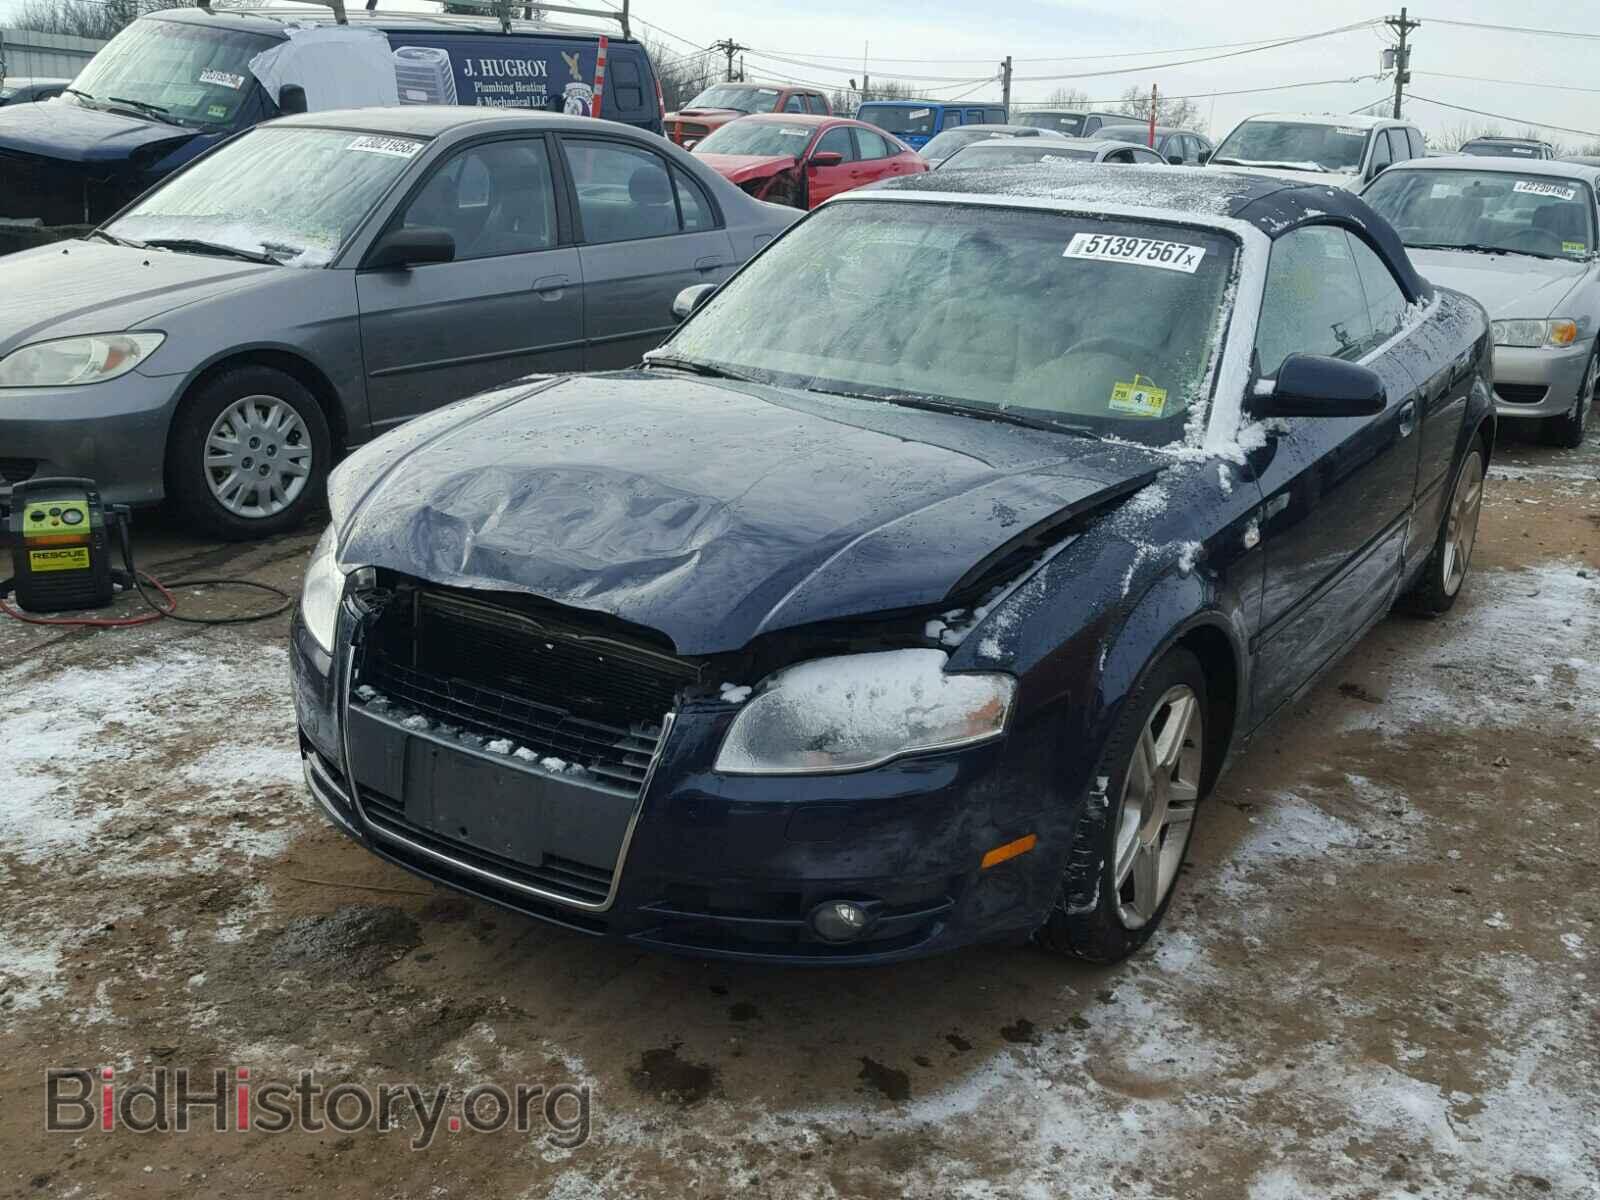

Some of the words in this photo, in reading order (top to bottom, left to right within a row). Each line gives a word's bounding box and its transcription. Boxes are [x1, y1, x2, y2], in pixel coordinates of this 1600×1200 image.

[464, 59, 478, 77] J.
[480, 59, 548, 77] HUGROY
[474, 82, 514, 95] Plumbing
[515, 81, 547, 94] Heating
[485, 96, 529, 109] Mechanical
[531, 96, 548, 107] LLC
[1135, 392, 1143, 404] 4
[32, 549, 86, 560] RESCUE
